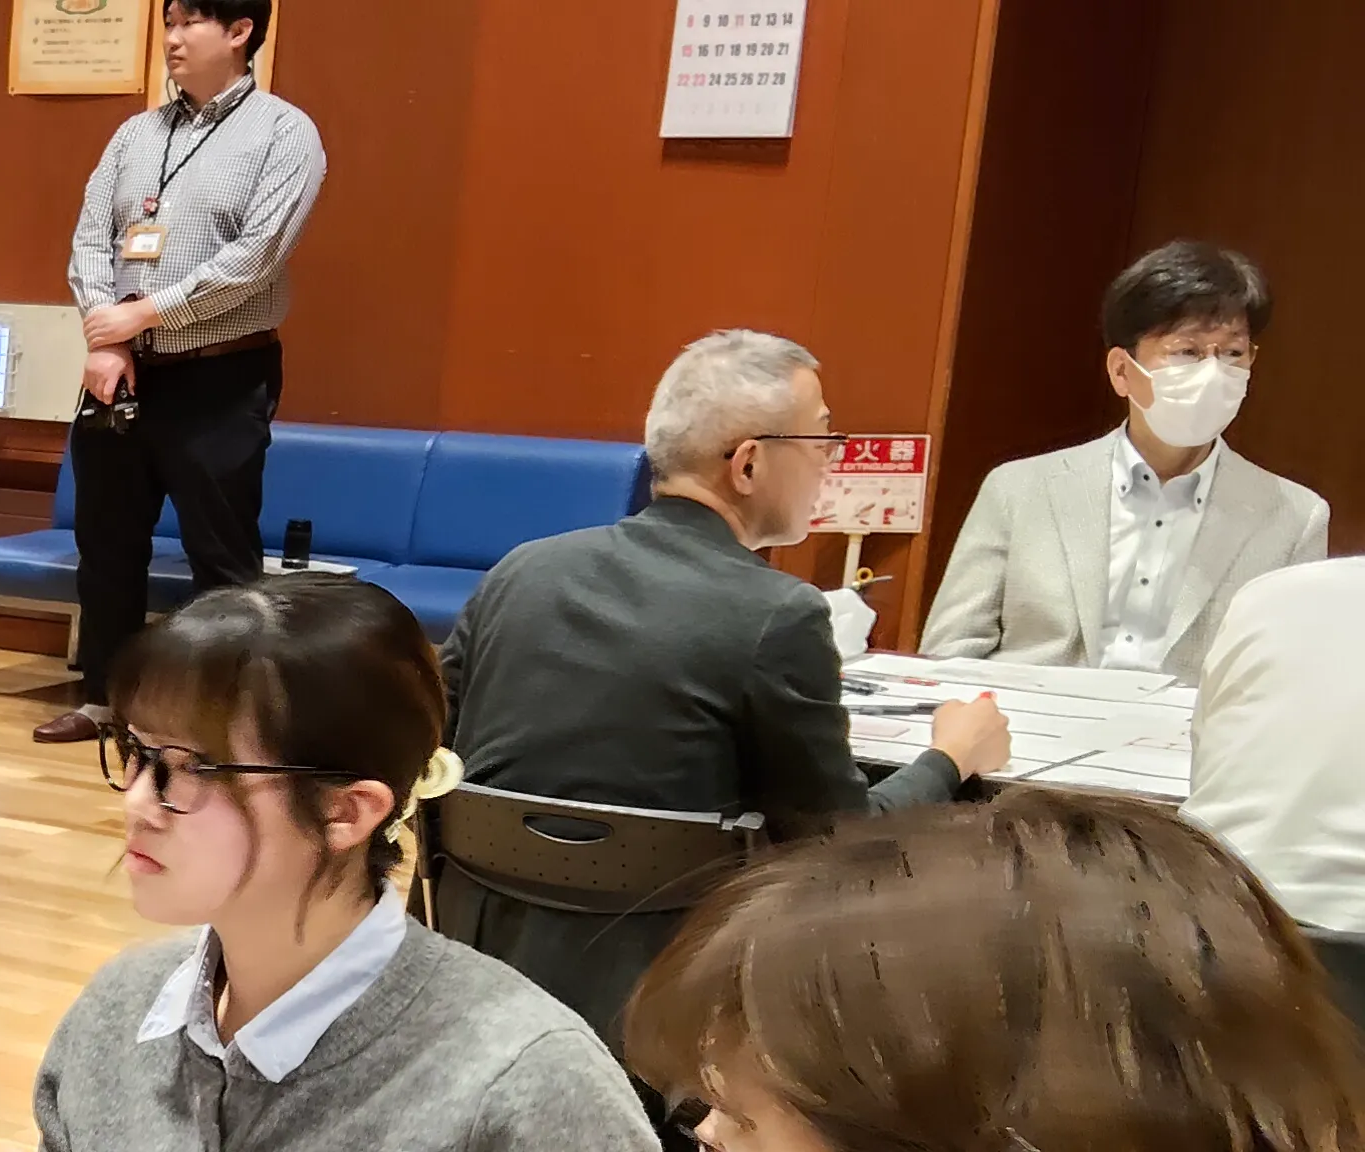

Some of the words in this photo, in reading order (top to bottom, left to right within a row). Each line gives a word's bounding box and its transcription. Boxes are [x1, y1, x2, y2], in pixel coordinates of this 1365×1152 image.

[703, 14, 711, 28] 9
[718, 14, 729, 27] 10
[735, 14, 745, 27] 11
[750, 13, 761, 27] 12
[766, 13, 777, 26] 13
[782, 13, 793, 26] 14
[698, 44, 709, 57] 16
[715, 44, 725, 57] 17
[730, 43, 741, 56] 18
[746, 43, 757, 56] 19
[760, 43, 774, 56] 20
[777, 42, 789, 56] 21
[677, 73, 690, 87] 22
[693, 73, 706, 87] 23
[709, 73, 721, 86] 24
[724, 73, 737, 86] 25
[740, 73, 754, 86] 26
[757, 73, 769, 86] 27
[772, 72, 786, 86] 28
